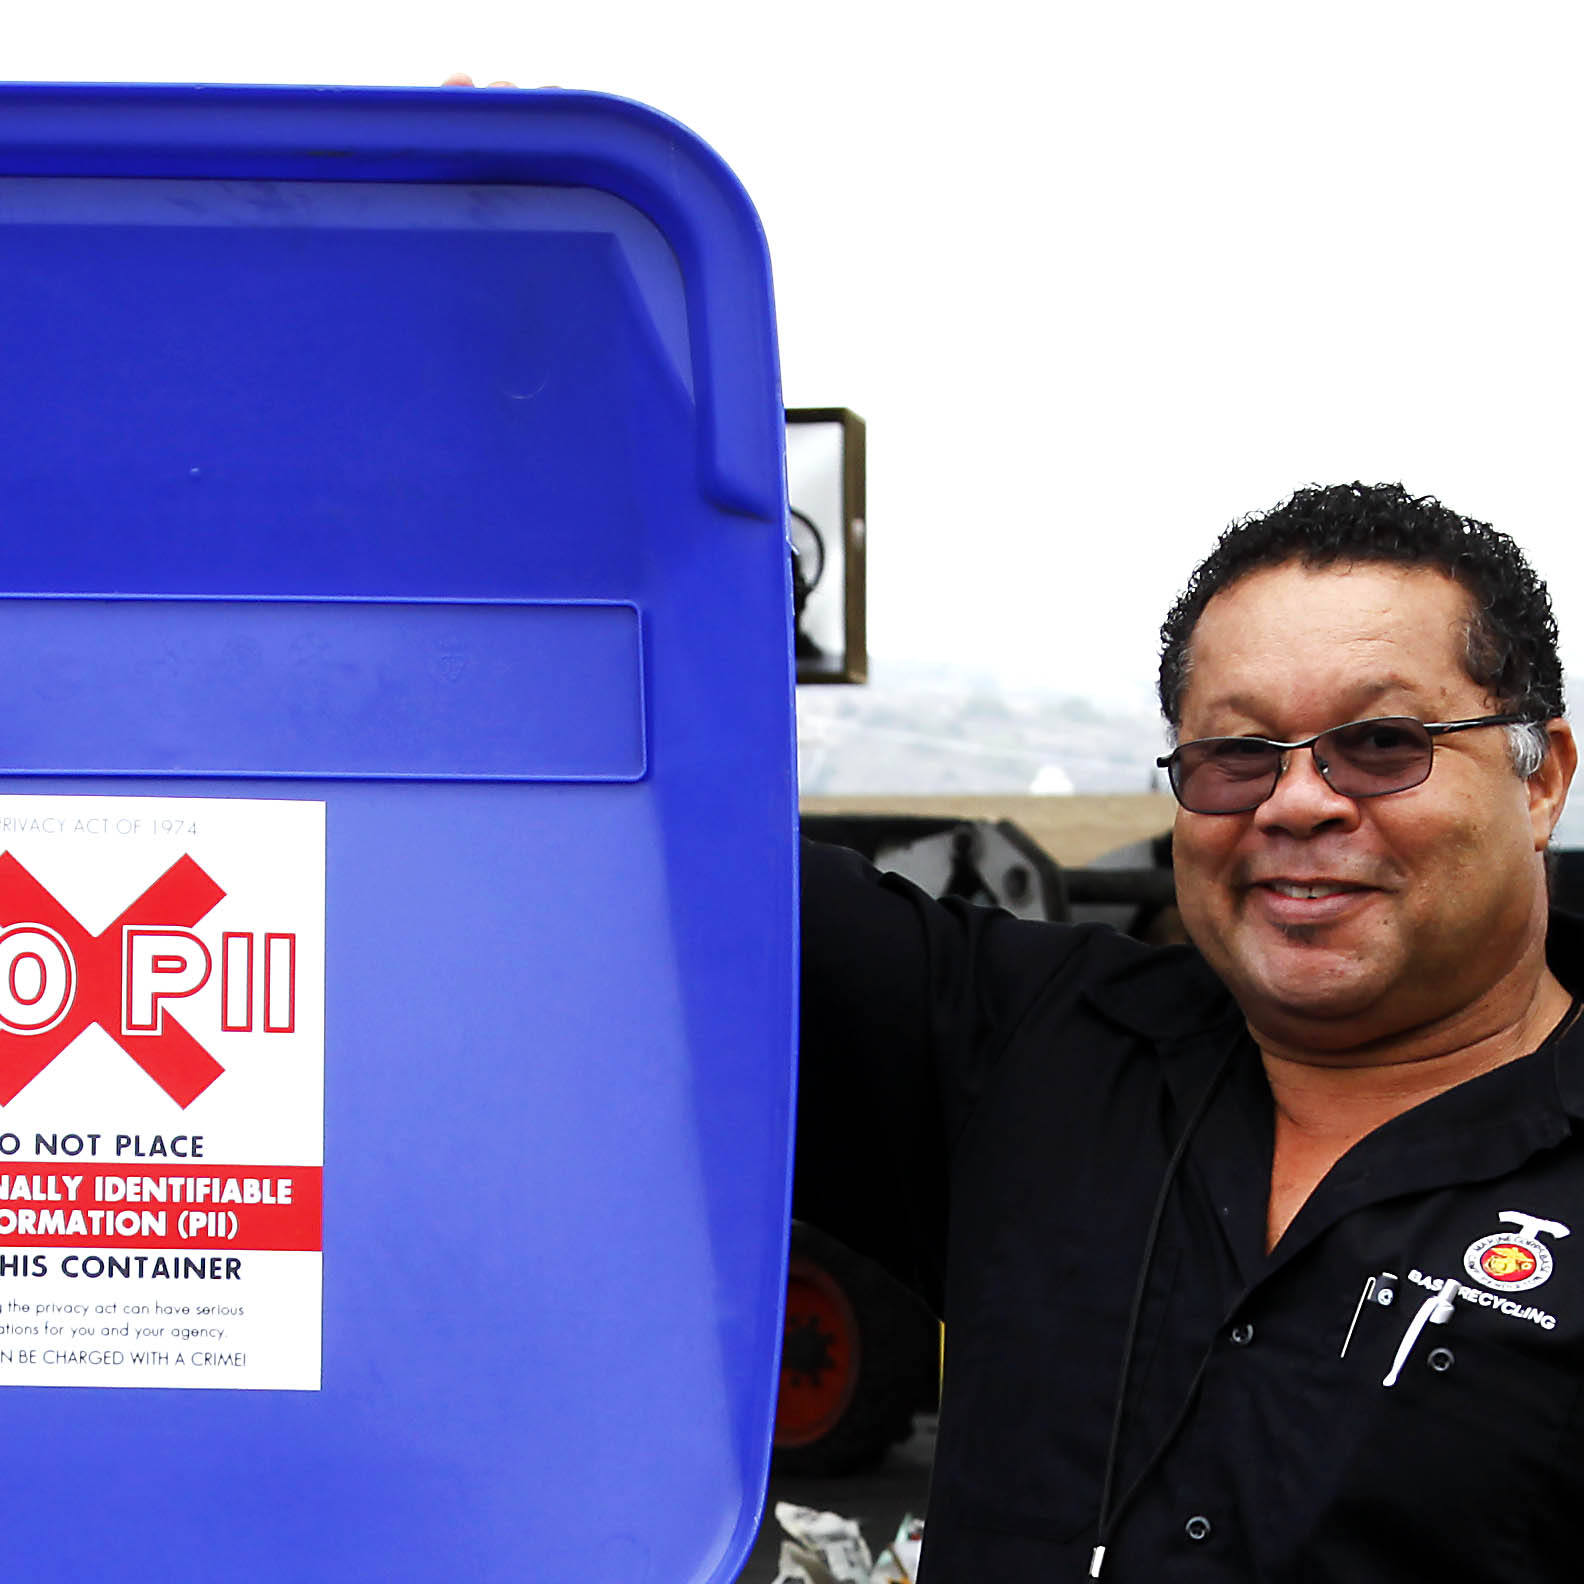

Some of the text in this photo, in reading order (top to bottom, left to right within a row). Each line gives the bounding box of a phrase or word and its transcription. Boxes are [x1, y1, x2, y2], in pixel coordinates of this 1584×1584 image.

[73, 817, 109, 835] ACT
[116, 818, 142, 835] OF
[152, 819, 201, 837] 1974
[122, 924, 297, 1035] PII
[34, 1132, 102, 1157] NOT
[115, 1134, 205, 1158] PLACE
[94, 1175, 293, 1205] IDENTIFIABLE
[177, 1210, 239, 1240] (PII)
[60, 1254, 242, 1281] CONTAINER
[7, 1298, 31, 1313] the
[35, 1302, 90, 1317] privacy
[94, 1301, 118, 1315] act
[122, 1304, 150, 1315] can
[154, 1300, 191, 1316] have
[195, 1304, 245, 1317] serious
[1407, 1269, 1445, 1292] BAS
[1458, 1286, 1557, 1330] RECYCLING
[44, 1320, 65, 1336] for
[70, 1326, 96, 1339] you
[100, 1321, 129, 1337] and
[134, 1327, 165, 1340] your
[170, 1327, 229, 1341] agency.
[18, 1349, 38, 1365] BE
[42, 1349, 125, 1366] CHARGED
[129, 1351, 169, 1366] WITH
[174, 1351, 186, 1366] A
